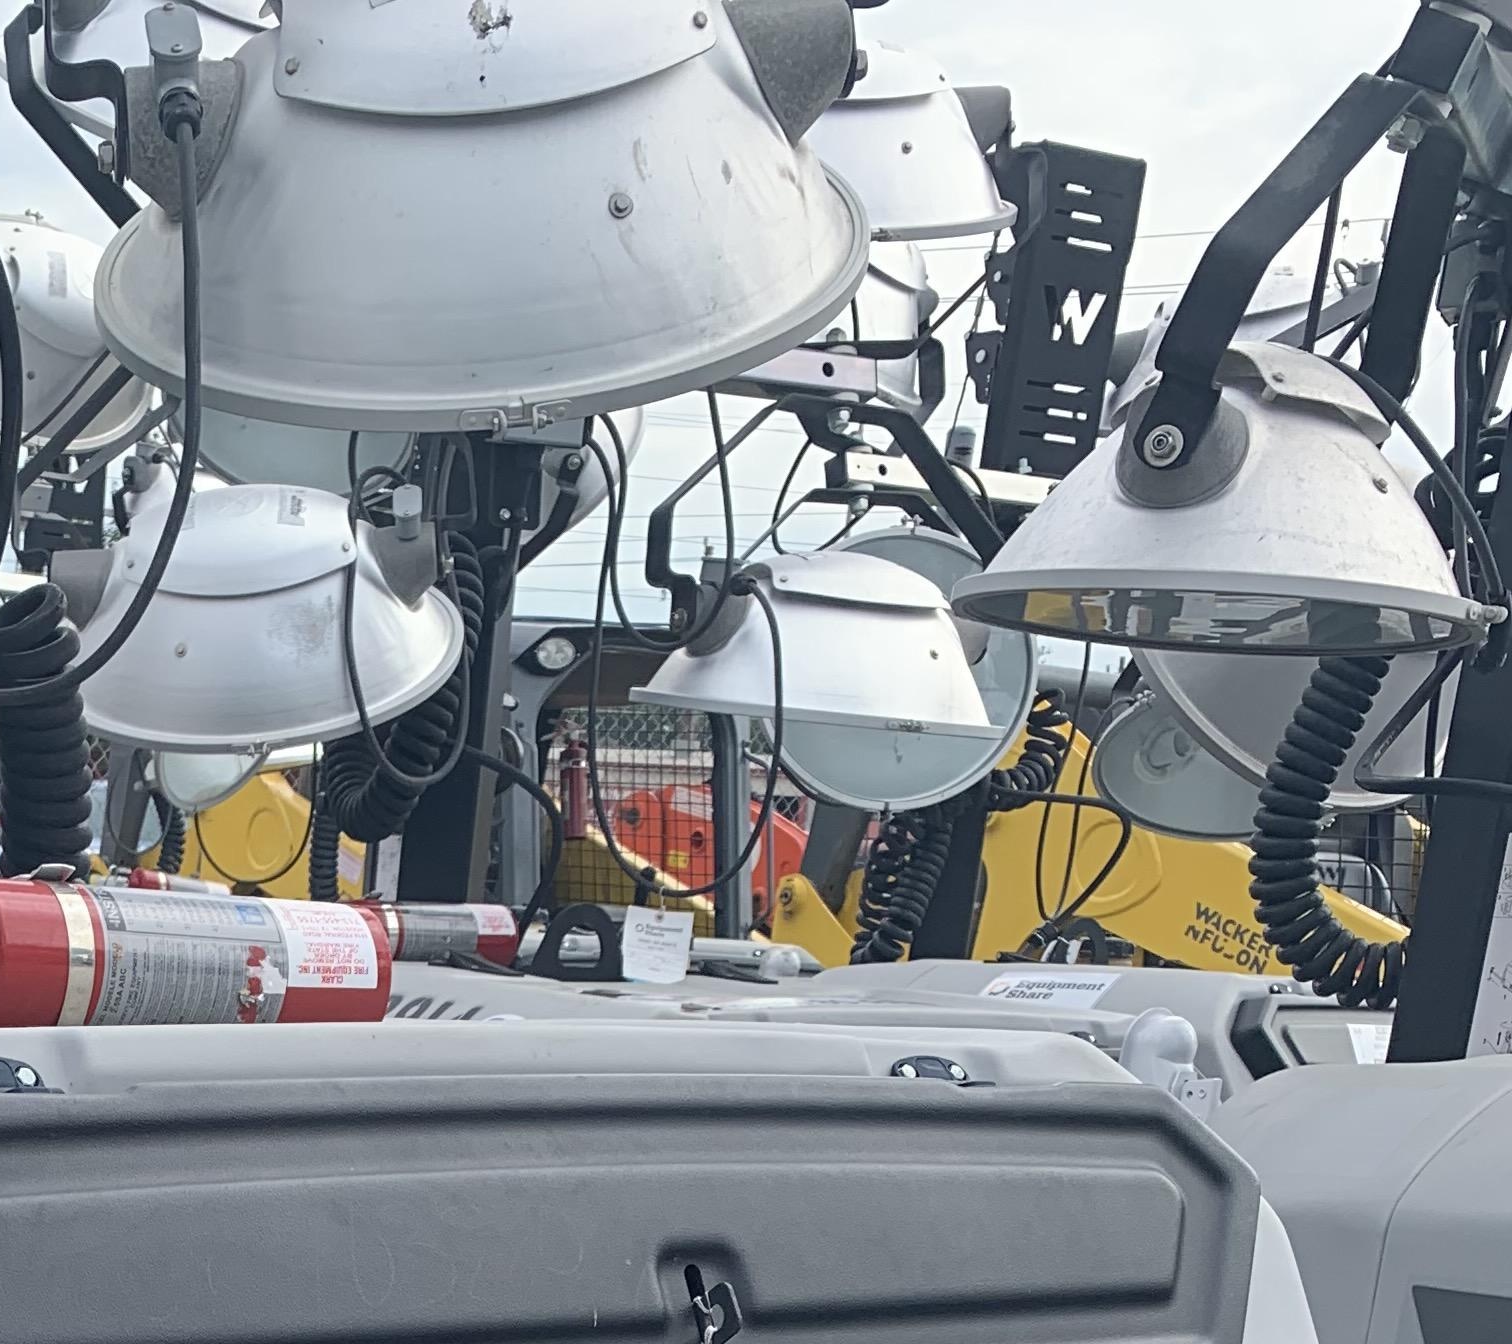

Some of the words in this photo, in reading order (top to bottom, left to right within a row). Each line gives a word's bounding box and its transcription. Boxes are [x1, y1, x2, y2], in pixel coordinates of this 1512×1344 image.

[1195, 901, 1272, 959] WACKER
[312, 966, 352, 975] EQUIPMENT
[354, 966, 369, 975] FIRE
[321, 975, 344, 984] CLARK
[1016, 980, 1106, 991] Equipment
[1005, 990, 1054, 1001] Share
